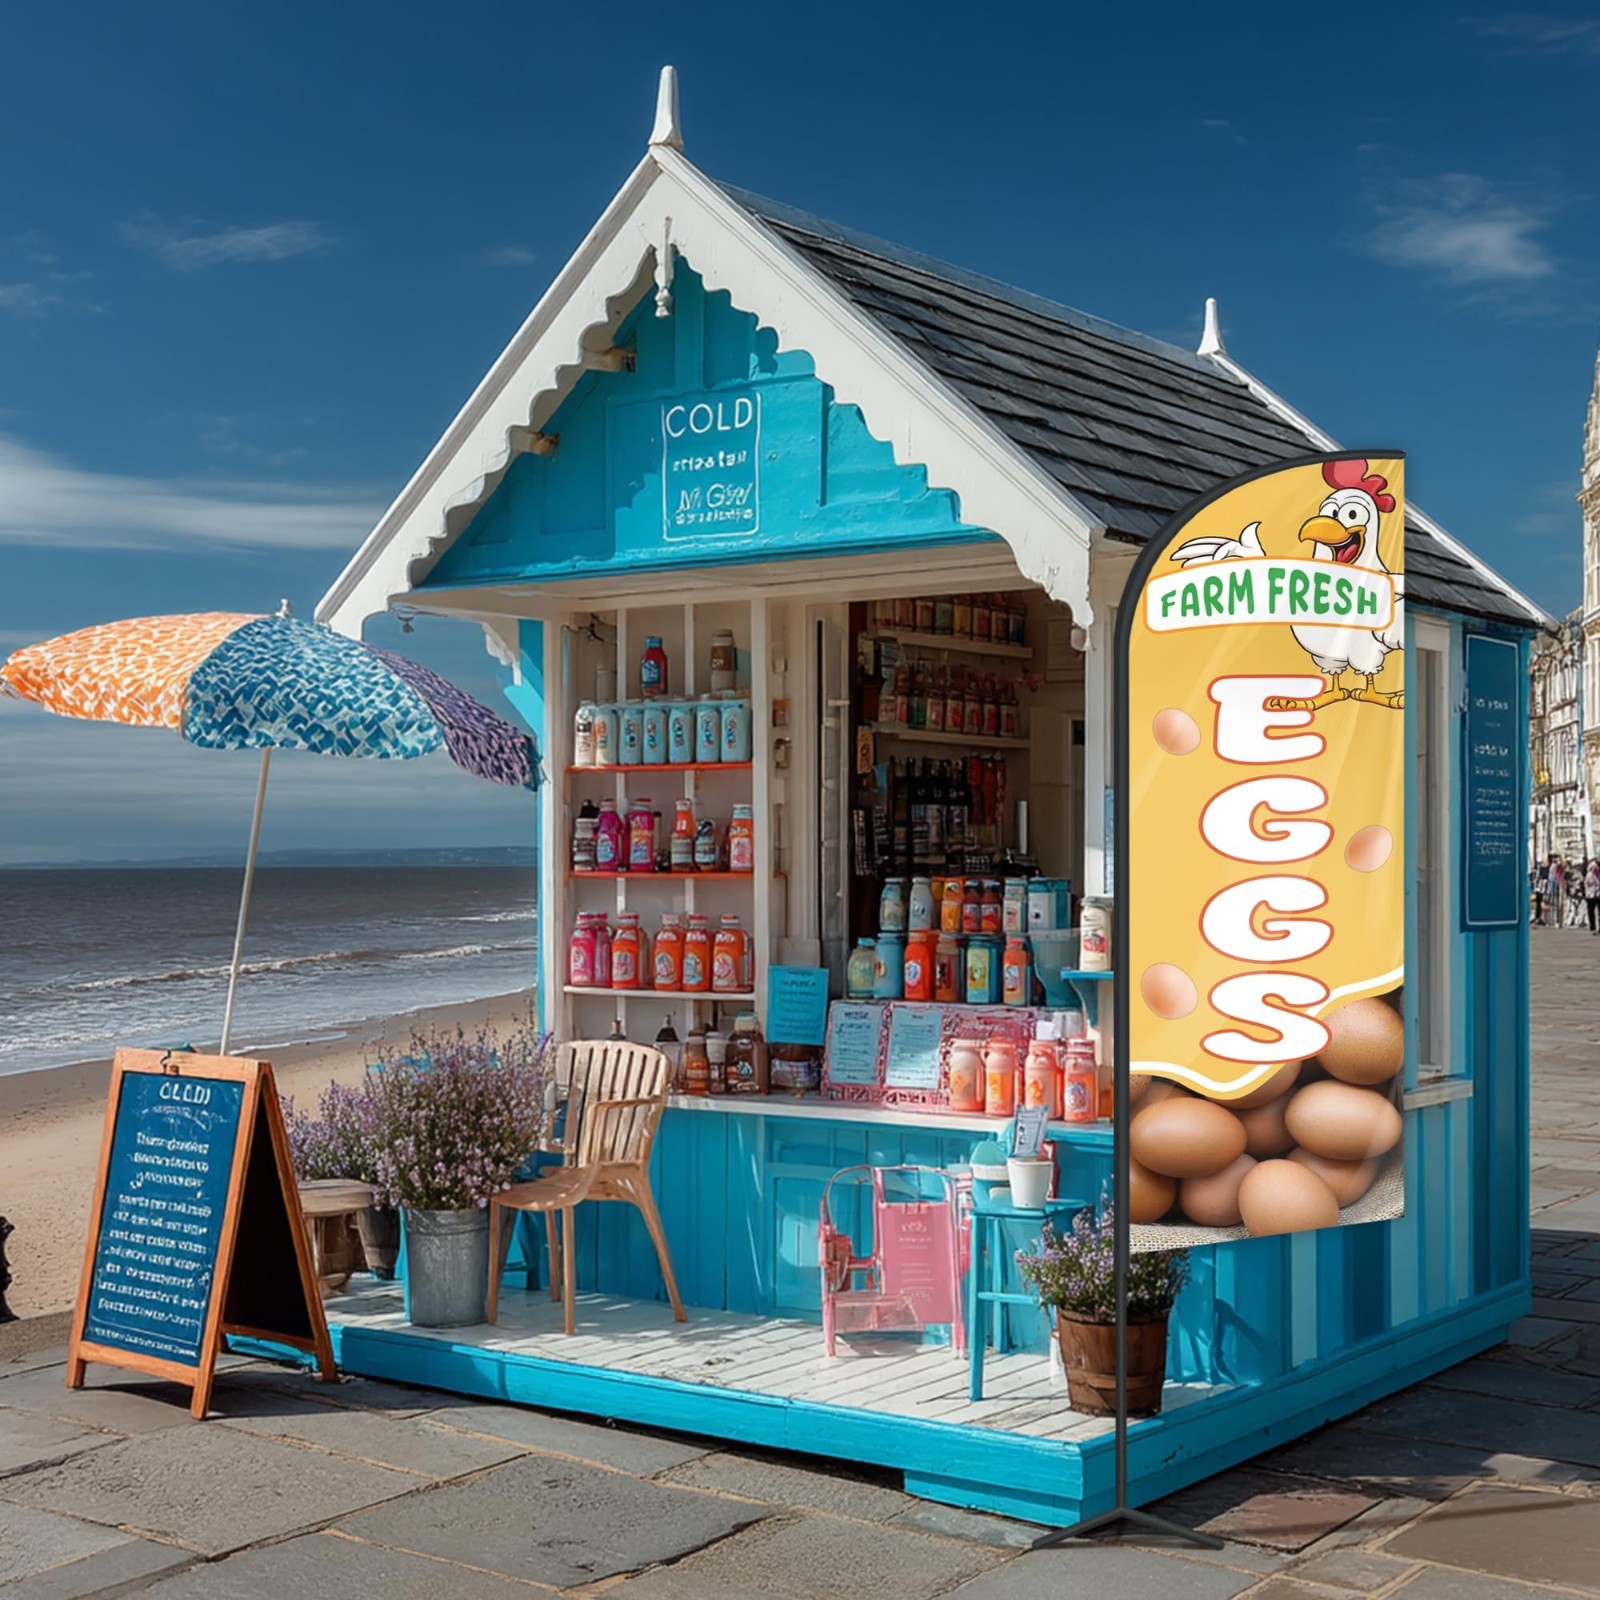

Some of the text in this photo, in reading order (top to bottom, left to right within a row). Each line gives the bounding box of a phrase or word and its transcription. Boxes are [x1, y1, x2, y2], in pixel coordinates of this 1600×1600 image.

[666, 397, 753, 438] COLD
[1160, 567, 1378, 617] FARM FRESH
[1198, 674, 1335, 1065] EGGS
